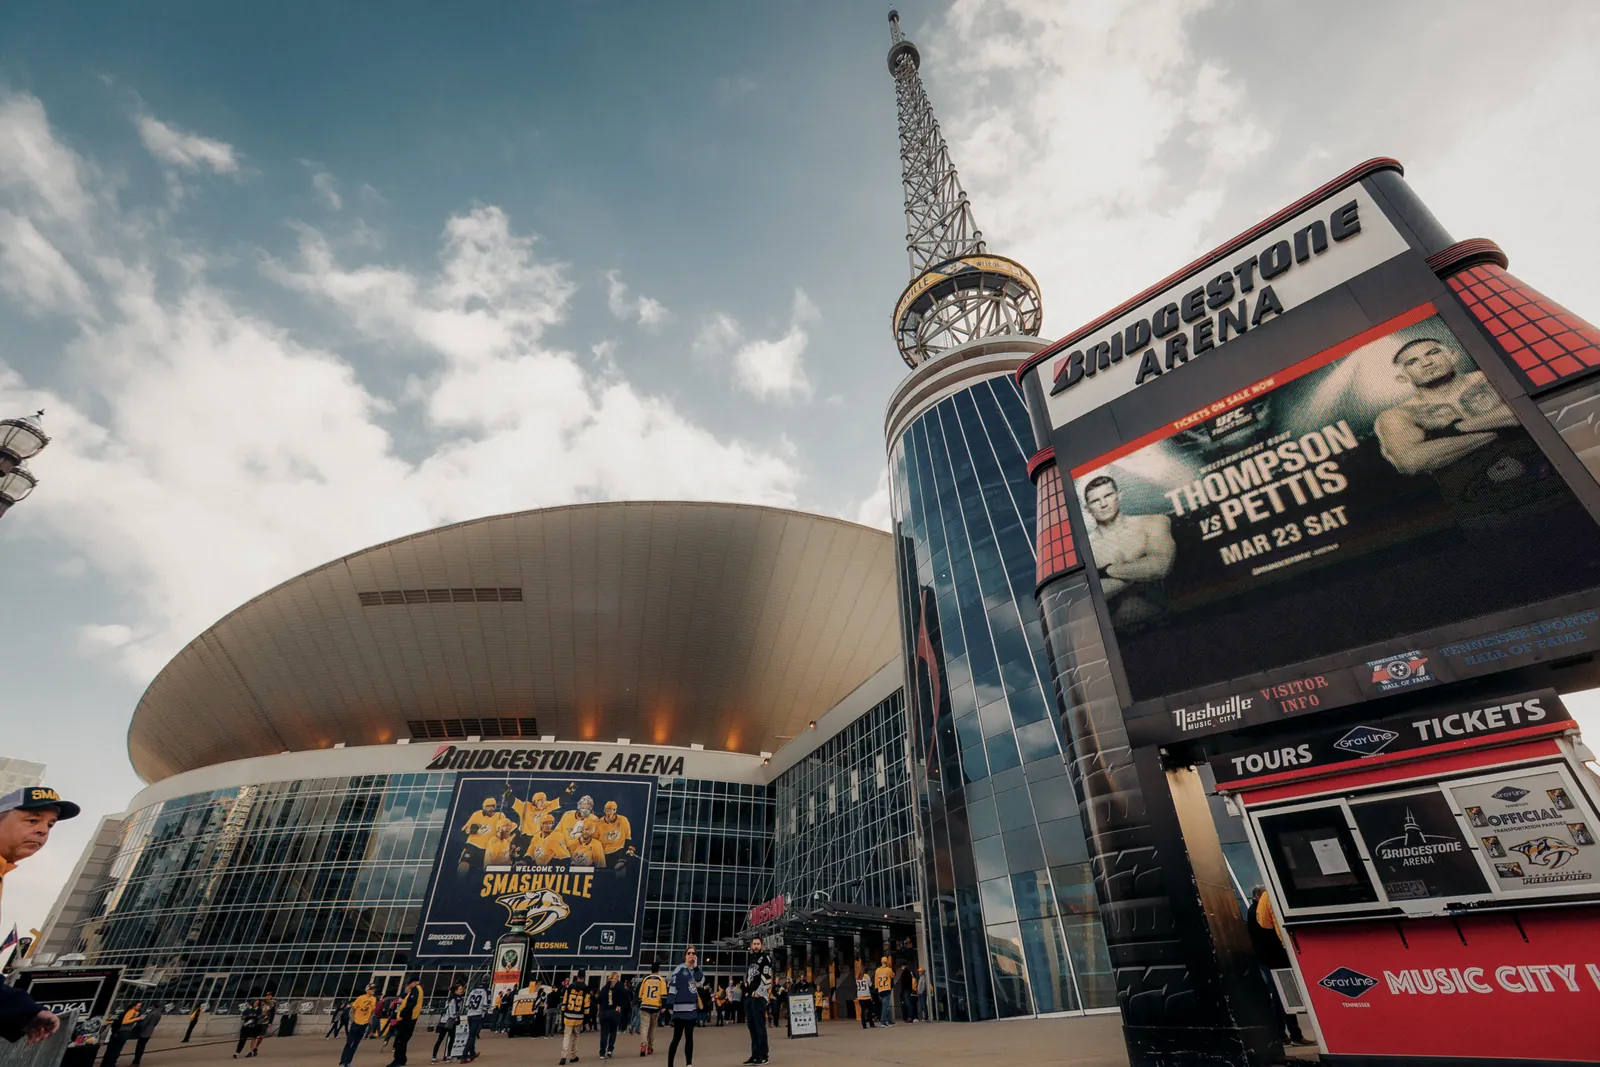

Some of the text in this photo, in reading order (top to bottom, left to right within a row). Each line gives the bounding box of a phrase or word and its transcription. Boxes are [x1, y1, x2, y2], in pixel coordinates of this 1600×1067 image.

[1050, 199, 1361, 397] BRIDGESTONE
[1135, 285, 1284, 385] ARENA
[1173, 408, 1210, 430] TICKETS
[1211, 402, 1226, 413] ON
[1226, 389, 1251, 406] SALE
[1251, 378, 1275, 394] NOW
[1215, 406, 1245, 428] UFC
[1163, 420, 1359, 517] THOMPSON
[1199, 461, 1348, 541] VS PETTIS
[1219, 533, 1272, 566] MAR
[1272, 523, 1303, 548] 23
[1303, 505, 1349, 536] SAT
[1440, 611, 1599, 657] TENNESSEE SPORTS
[1366, 650, 1421, 667] TENNESSEE SPORTS
[1464, 630, 1588, 666] HALL OF FAME
[1260, 675, 1329, 702] VISITOR
[1381, 675, 1431, 691] HALL OF FAME
[1172, 694, 1252, 731] Nashville
[1280, 694, 1320, 713] INFO
[1187, 714, 1237, 731] MUSIC CITY
[1412, 698, 1547, 741] TICKETS
[425, 745, 684, 776] BRIDGESTONE ARENA
[1231, 743, 1314, 776] TOURS
[1488, 807, 1563, 826] OFFICIAL
[1493, 820, 1568, 834] TRANSPORTATION PARTNER
[1381, 841, 1462, 859] BRIDGESTONE
[1402, 856, 1435, 867] ARENA
[515, 865, 565, 873] WELCOME TO
[1522, 872, 1592, 885] PREDATORS
[480, 873, 594, 899] SMASHVILLE
[534, 941, 569, 949] REDSNHL
[878, 976, 889, 988] 22
[1383, 967, 1494, 995] MUSIC
[1494, 963, 1581, 993] CITY
[568, 994, 583, 1012] 59
[647, 985, 659, 999] 12
